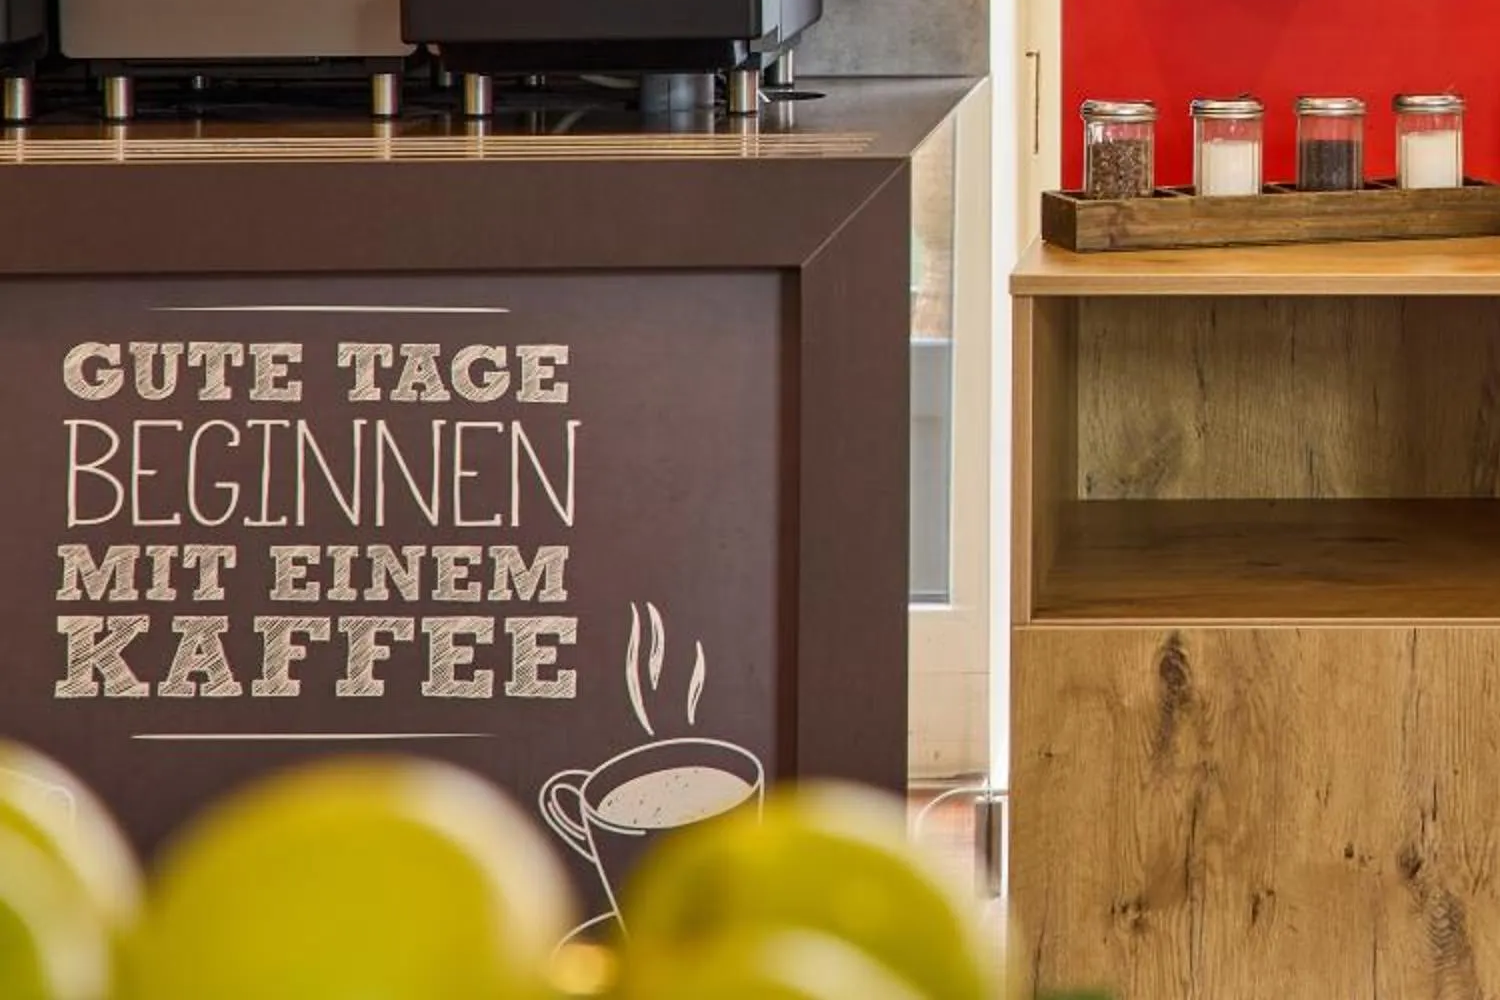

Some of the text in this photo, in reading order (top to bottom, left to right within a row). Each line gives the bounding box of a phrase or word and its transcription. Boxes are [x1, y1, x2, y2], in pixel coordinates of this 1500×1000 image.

[63, 341, 570, 404] GUTE TAGE
[63, 419, 582, 528] BEGINNEN
[55, 543, 569, 603] MIT EINEM
[54, 614, 579, 699] KAFFEE
